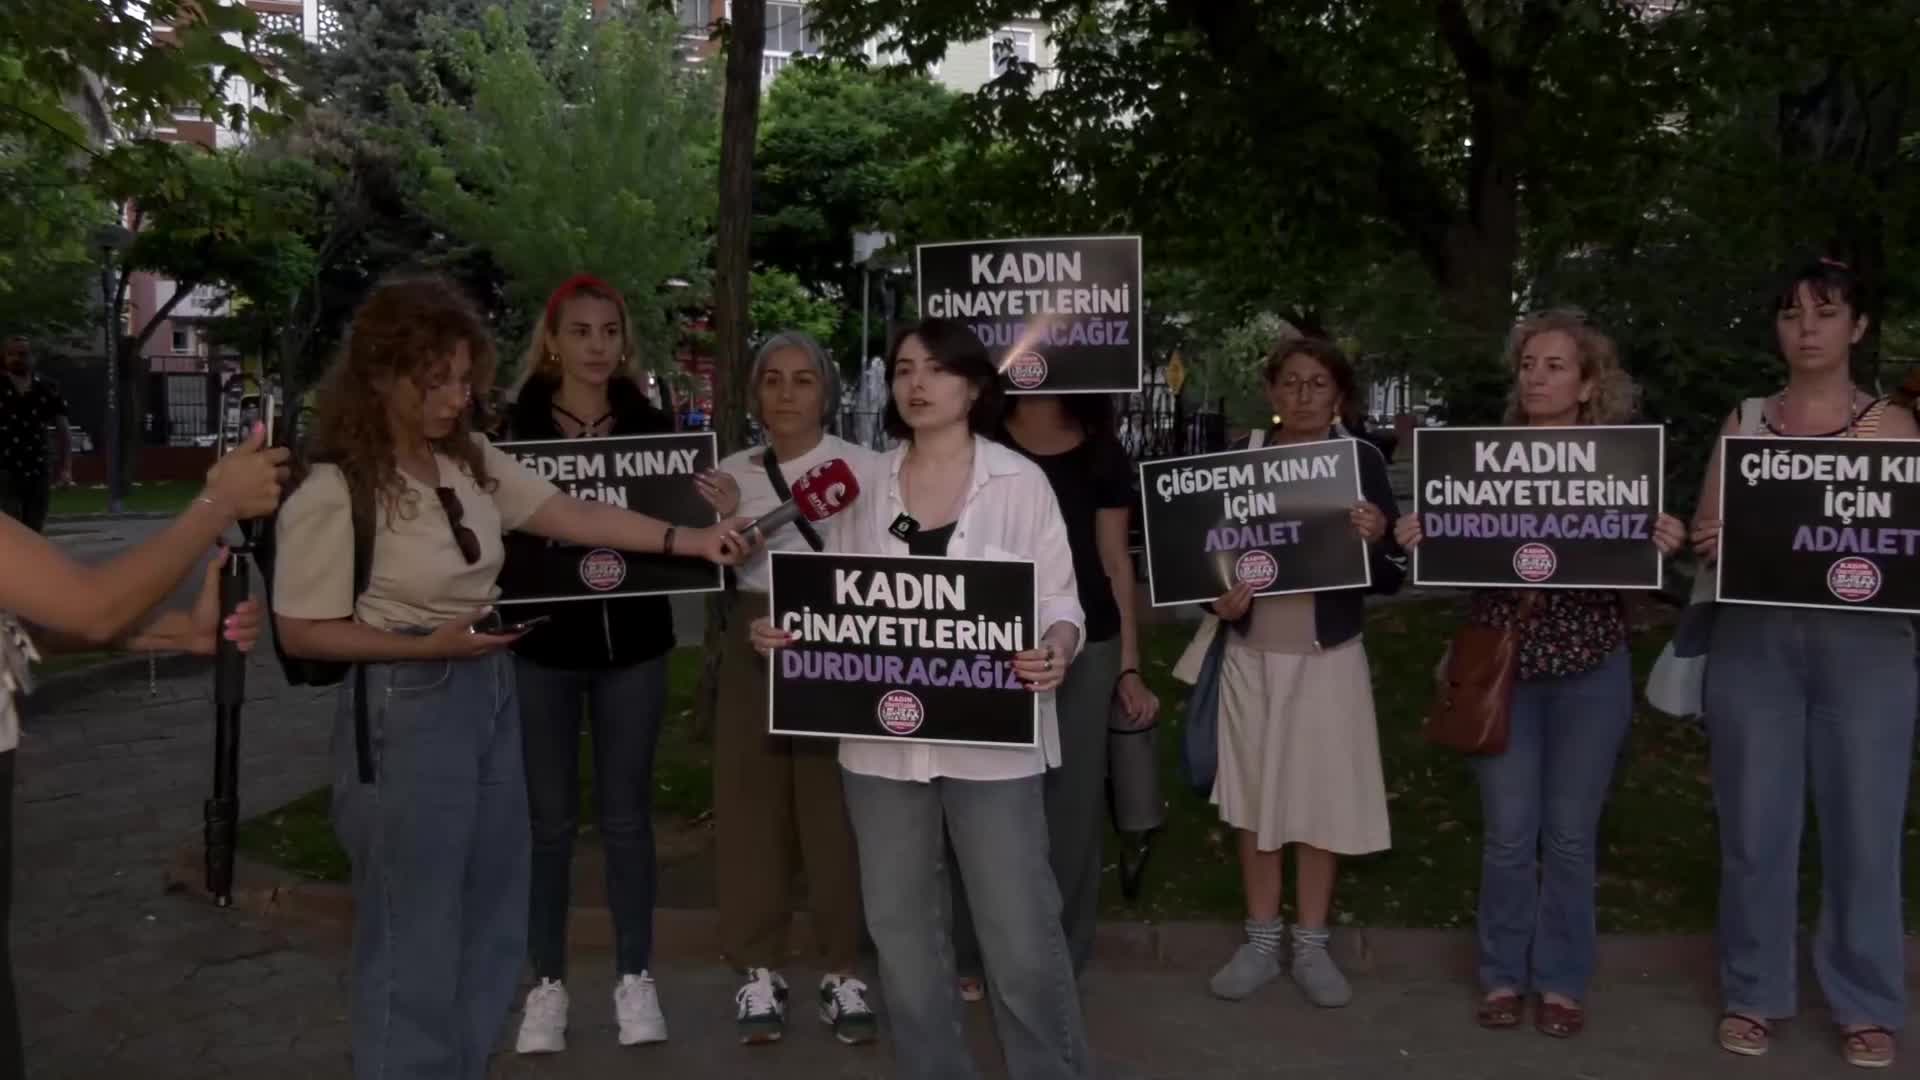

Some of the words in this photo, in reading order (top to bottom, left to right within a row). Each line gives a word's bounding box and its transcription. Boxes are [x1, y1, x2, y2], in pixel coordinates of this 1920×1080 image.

[971, 252, 1082, 284] KADIN
[928, 283, 1129, 318] CİNAYETLERİNİ
[615, 449, 699, 477] KINAY
[1475, 441, 1596, 474] KADIN
[1740, 448, 1869, 487] ÇİĞDEM
[1881, 455, 1920, 484] KI
[1157, 463, 1256, 503] ÇİĞDEM
[1262, 454, 1340, 484] KINAY
[1425, 474, 1649, 506] CİNAYETLERİNİ
[1223, 489, 1277, 524] İÇİN
[1824, 485, 1892, 525] İÇİN
[1204, 520, 1302, 552] ADALET
[1425, 509, 1649, 540] DURDURACAĞIZ
[1792, 525, 1920, 555] ADALET
[835, 569, 966, 611] KADIN
[783, 606, 1024, 651] CİNAYETLERİNİ
